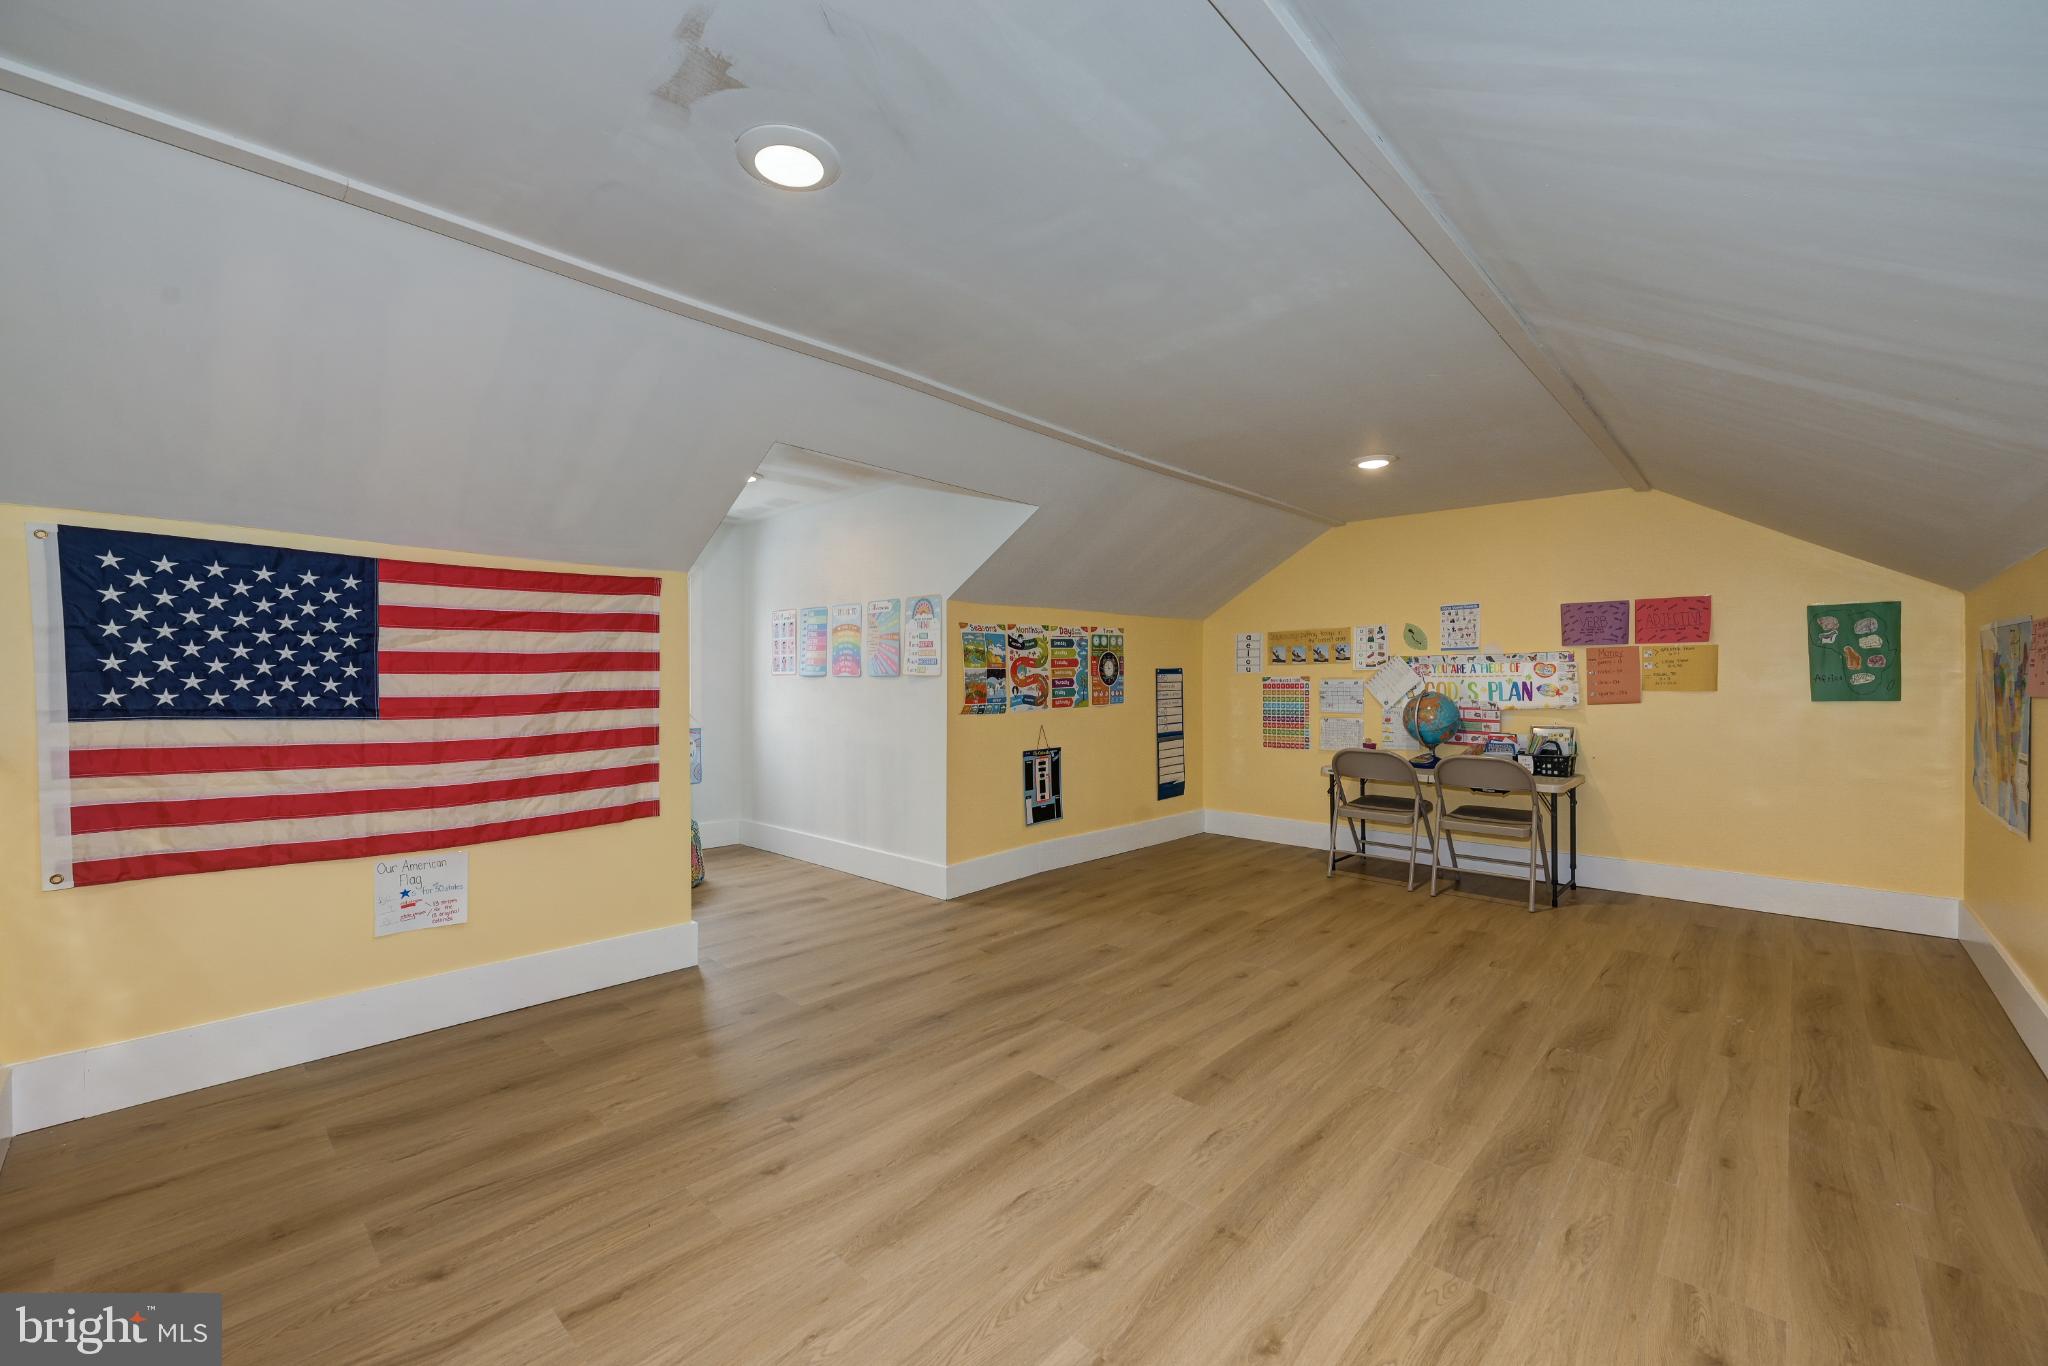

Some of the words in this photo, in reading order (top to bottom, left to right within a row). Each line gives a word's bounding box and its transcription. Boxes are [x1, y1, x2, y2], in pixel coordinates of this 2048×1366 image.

[969, 624, 997, 632] Seasons
[1016, 625, 1038, 633] Months
[1059, 626, 1075, 637] Days
[1431, 663, 1448, 674] YOU
[1451, 663, 1466, 674] ARE
[1470, 663, 1477, 674] A
[1509, 662, 1521, 673] OF
[1487, 680, 1533, 702] PLAN
[377, 862, 398, 875] Our
[402, 859, 447, 872] American
[400, 874, 422, 890] Flag
